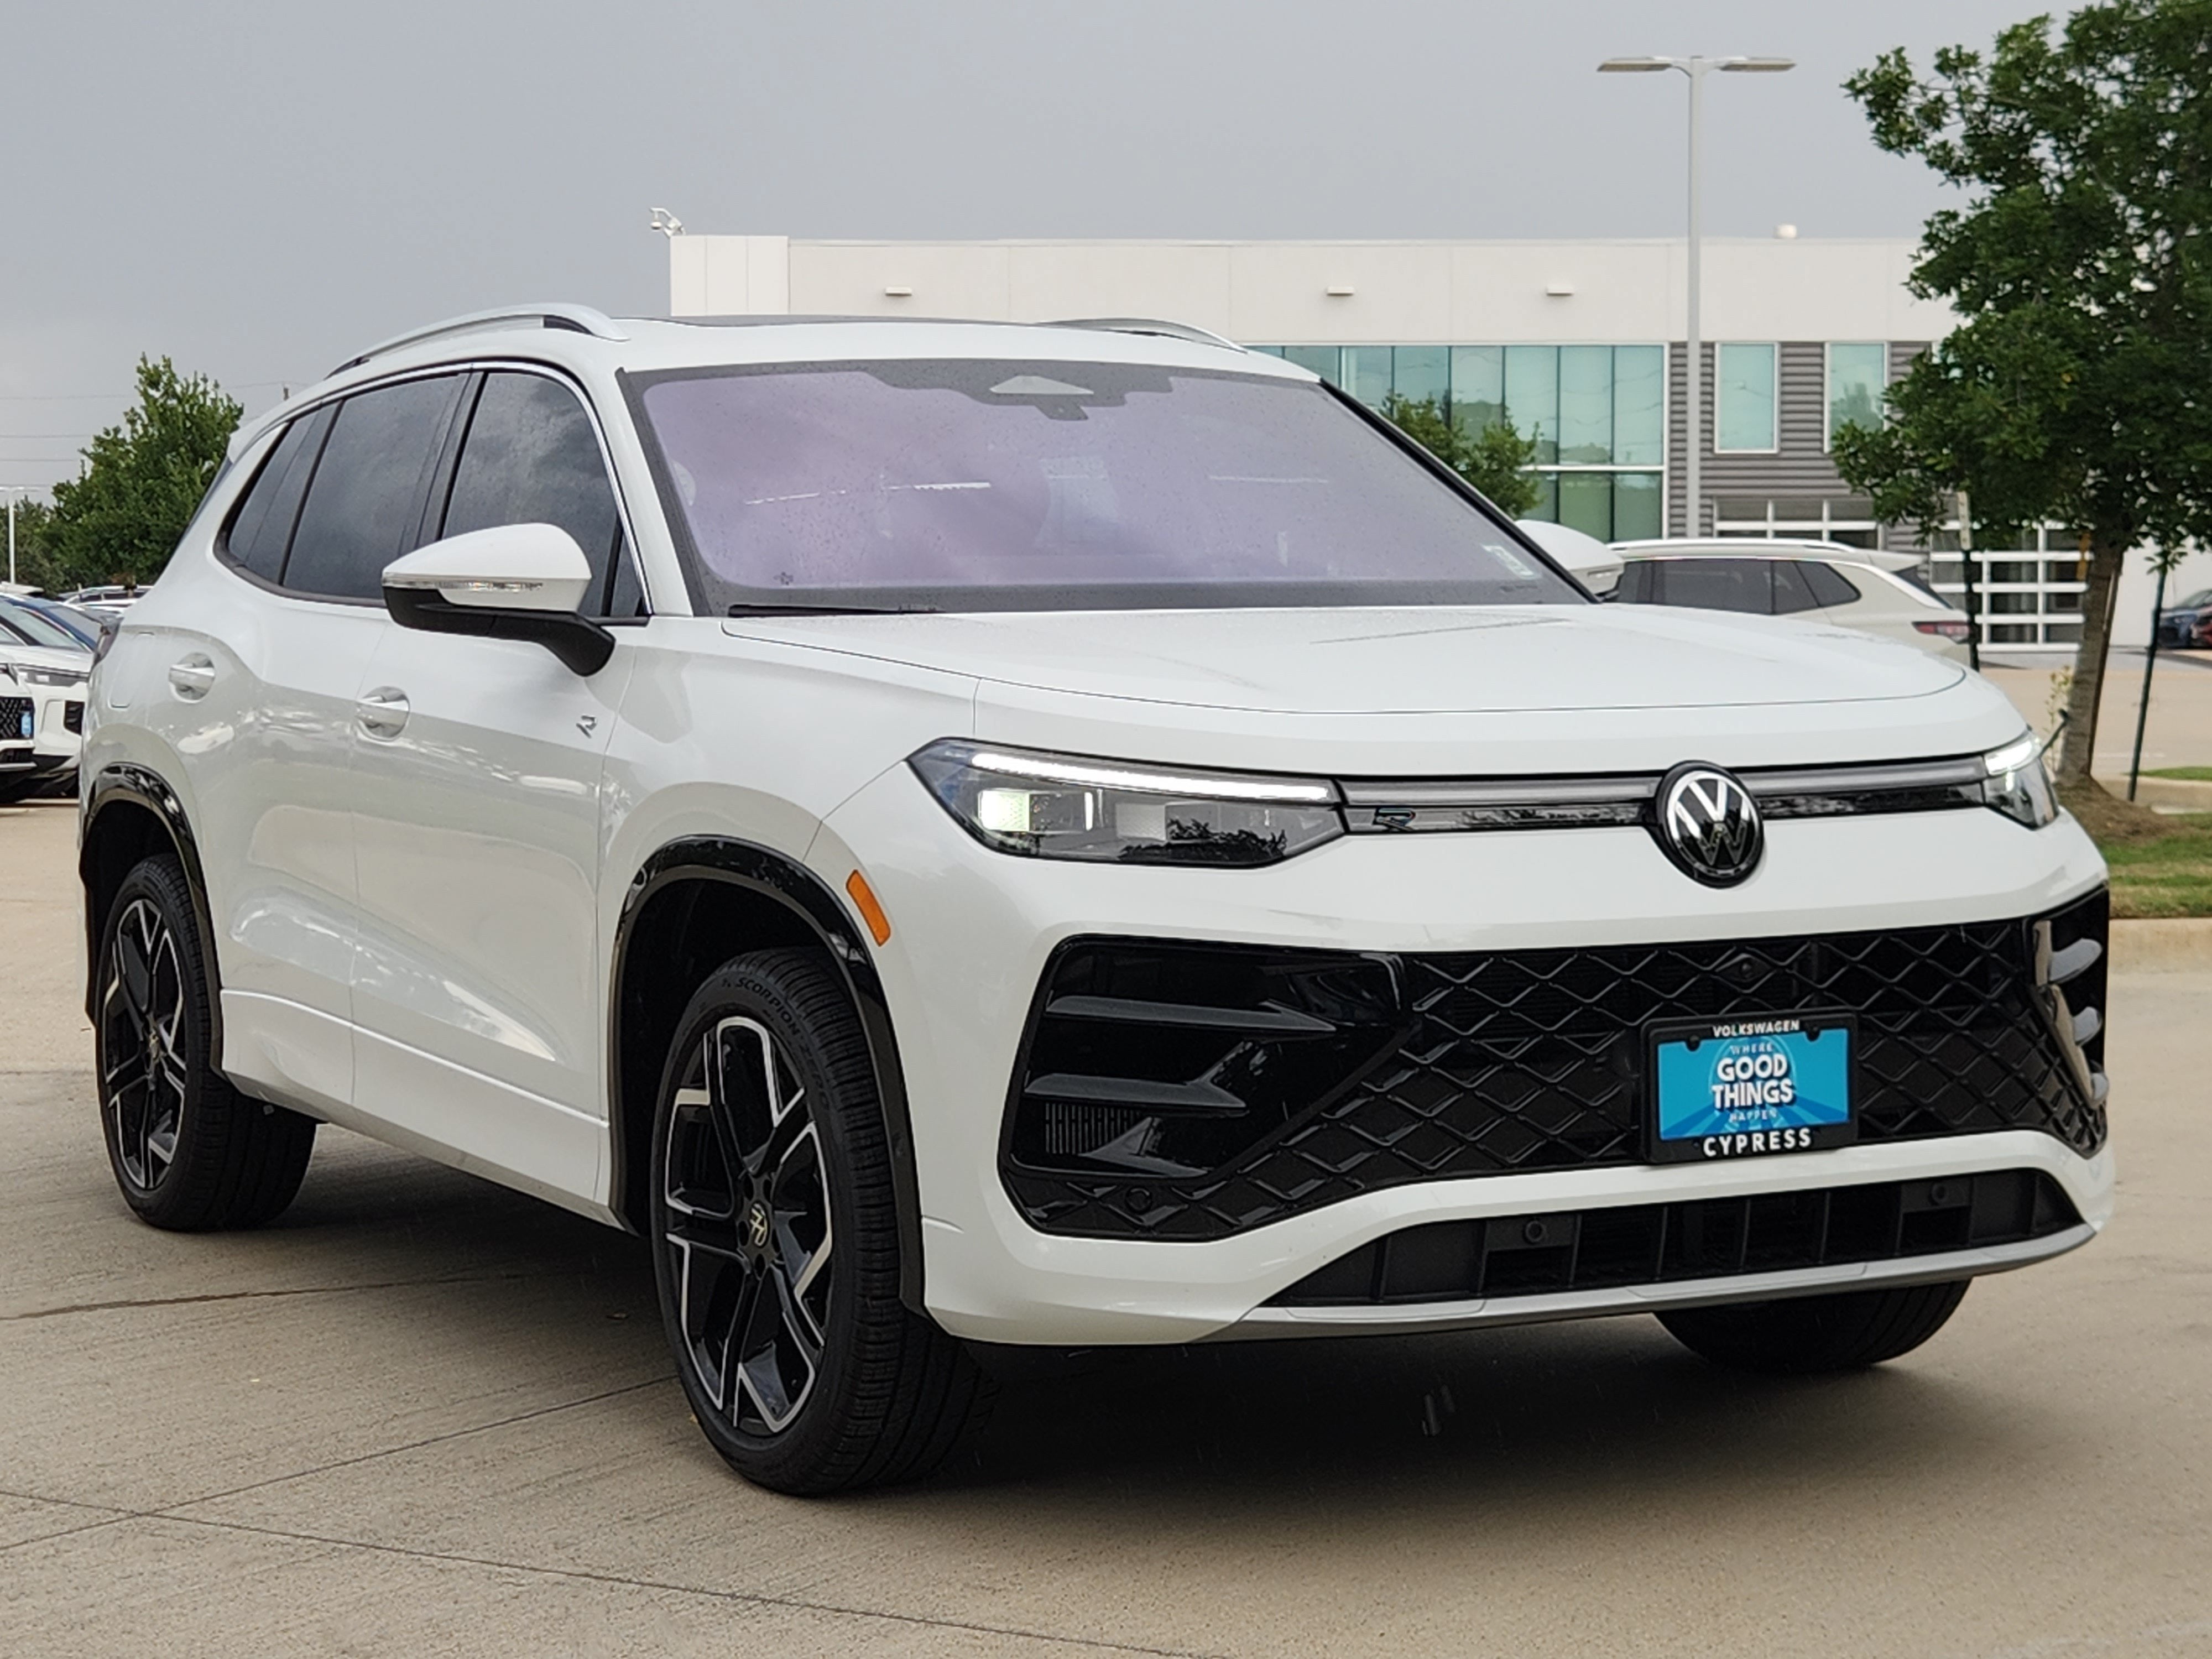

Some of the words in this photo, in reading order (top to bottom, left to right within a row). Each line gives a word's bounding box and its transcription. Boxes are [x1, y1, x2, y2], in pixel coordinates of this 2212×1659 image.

[576, 714, 597, 739] R
[736, 977, 800, 1035] SCORPION
[1713, 1020, 1799, 1038] VOLKSWAGEN
[1730, 1042, 1773, 1055] WHERE
[1717, 1053, 1787, 1082] GOOD
[1712, 1078, 1793, 1109] THINGS
[1729, 1109, 1777, 1122] HAPPEN
[1703, 1128, 1811, 1157] CYPRESS
